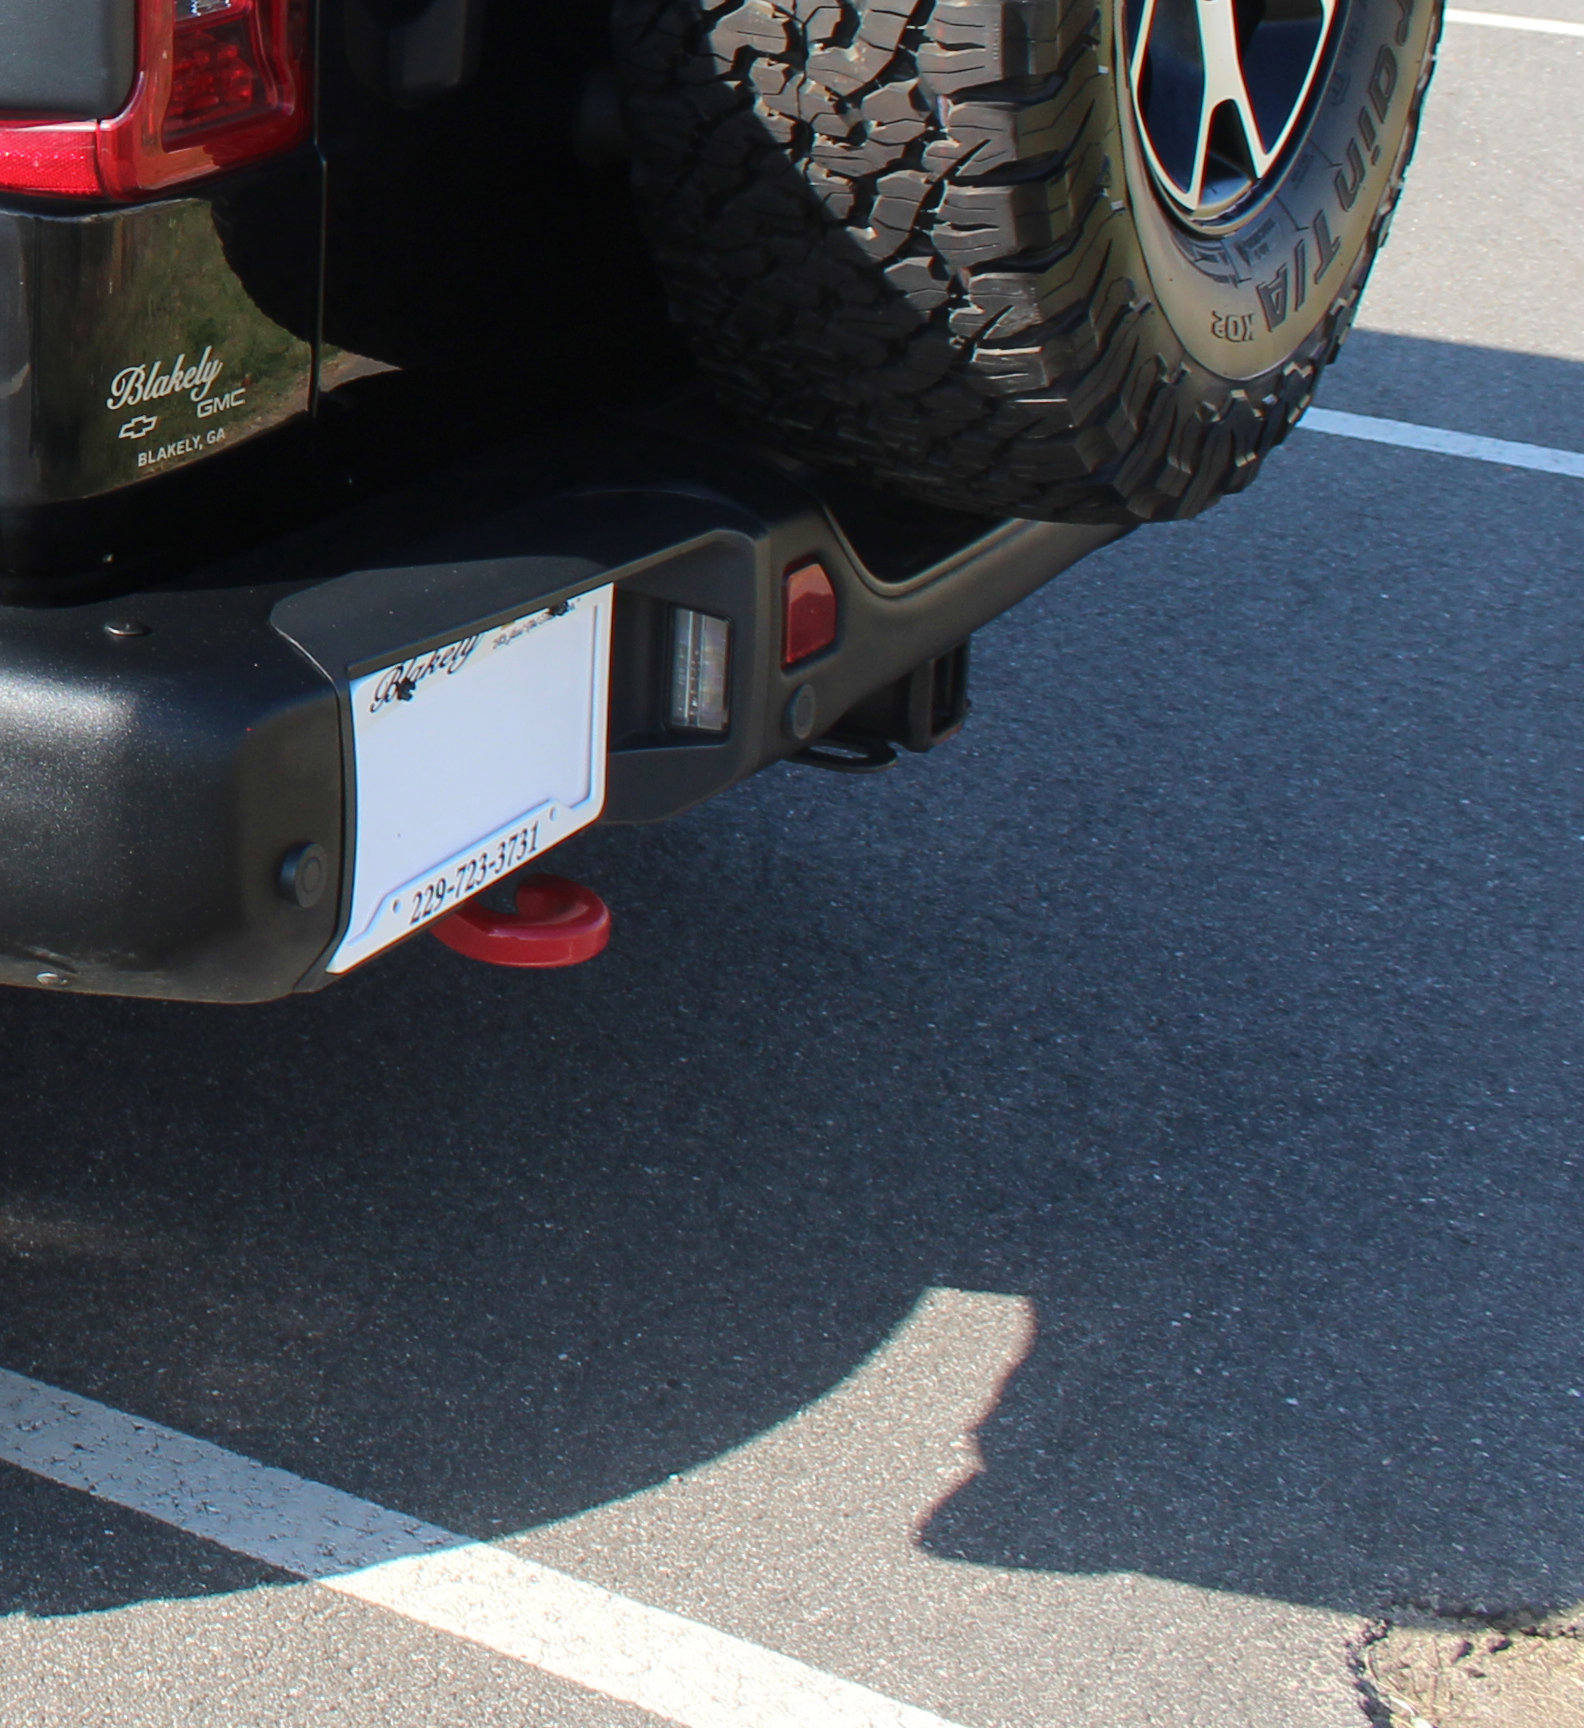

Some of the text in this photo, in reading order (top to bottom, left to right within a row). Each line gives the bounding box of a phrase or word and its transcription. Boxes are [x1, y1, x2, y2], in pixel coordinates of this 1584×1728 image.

[106, 345, 223, 410] Blakely
[197, 388, 246, 418] GMC
[137, 427, 226, 467] BLAKELY, GA
[409, 821, 540, 926] 229-723-3731
